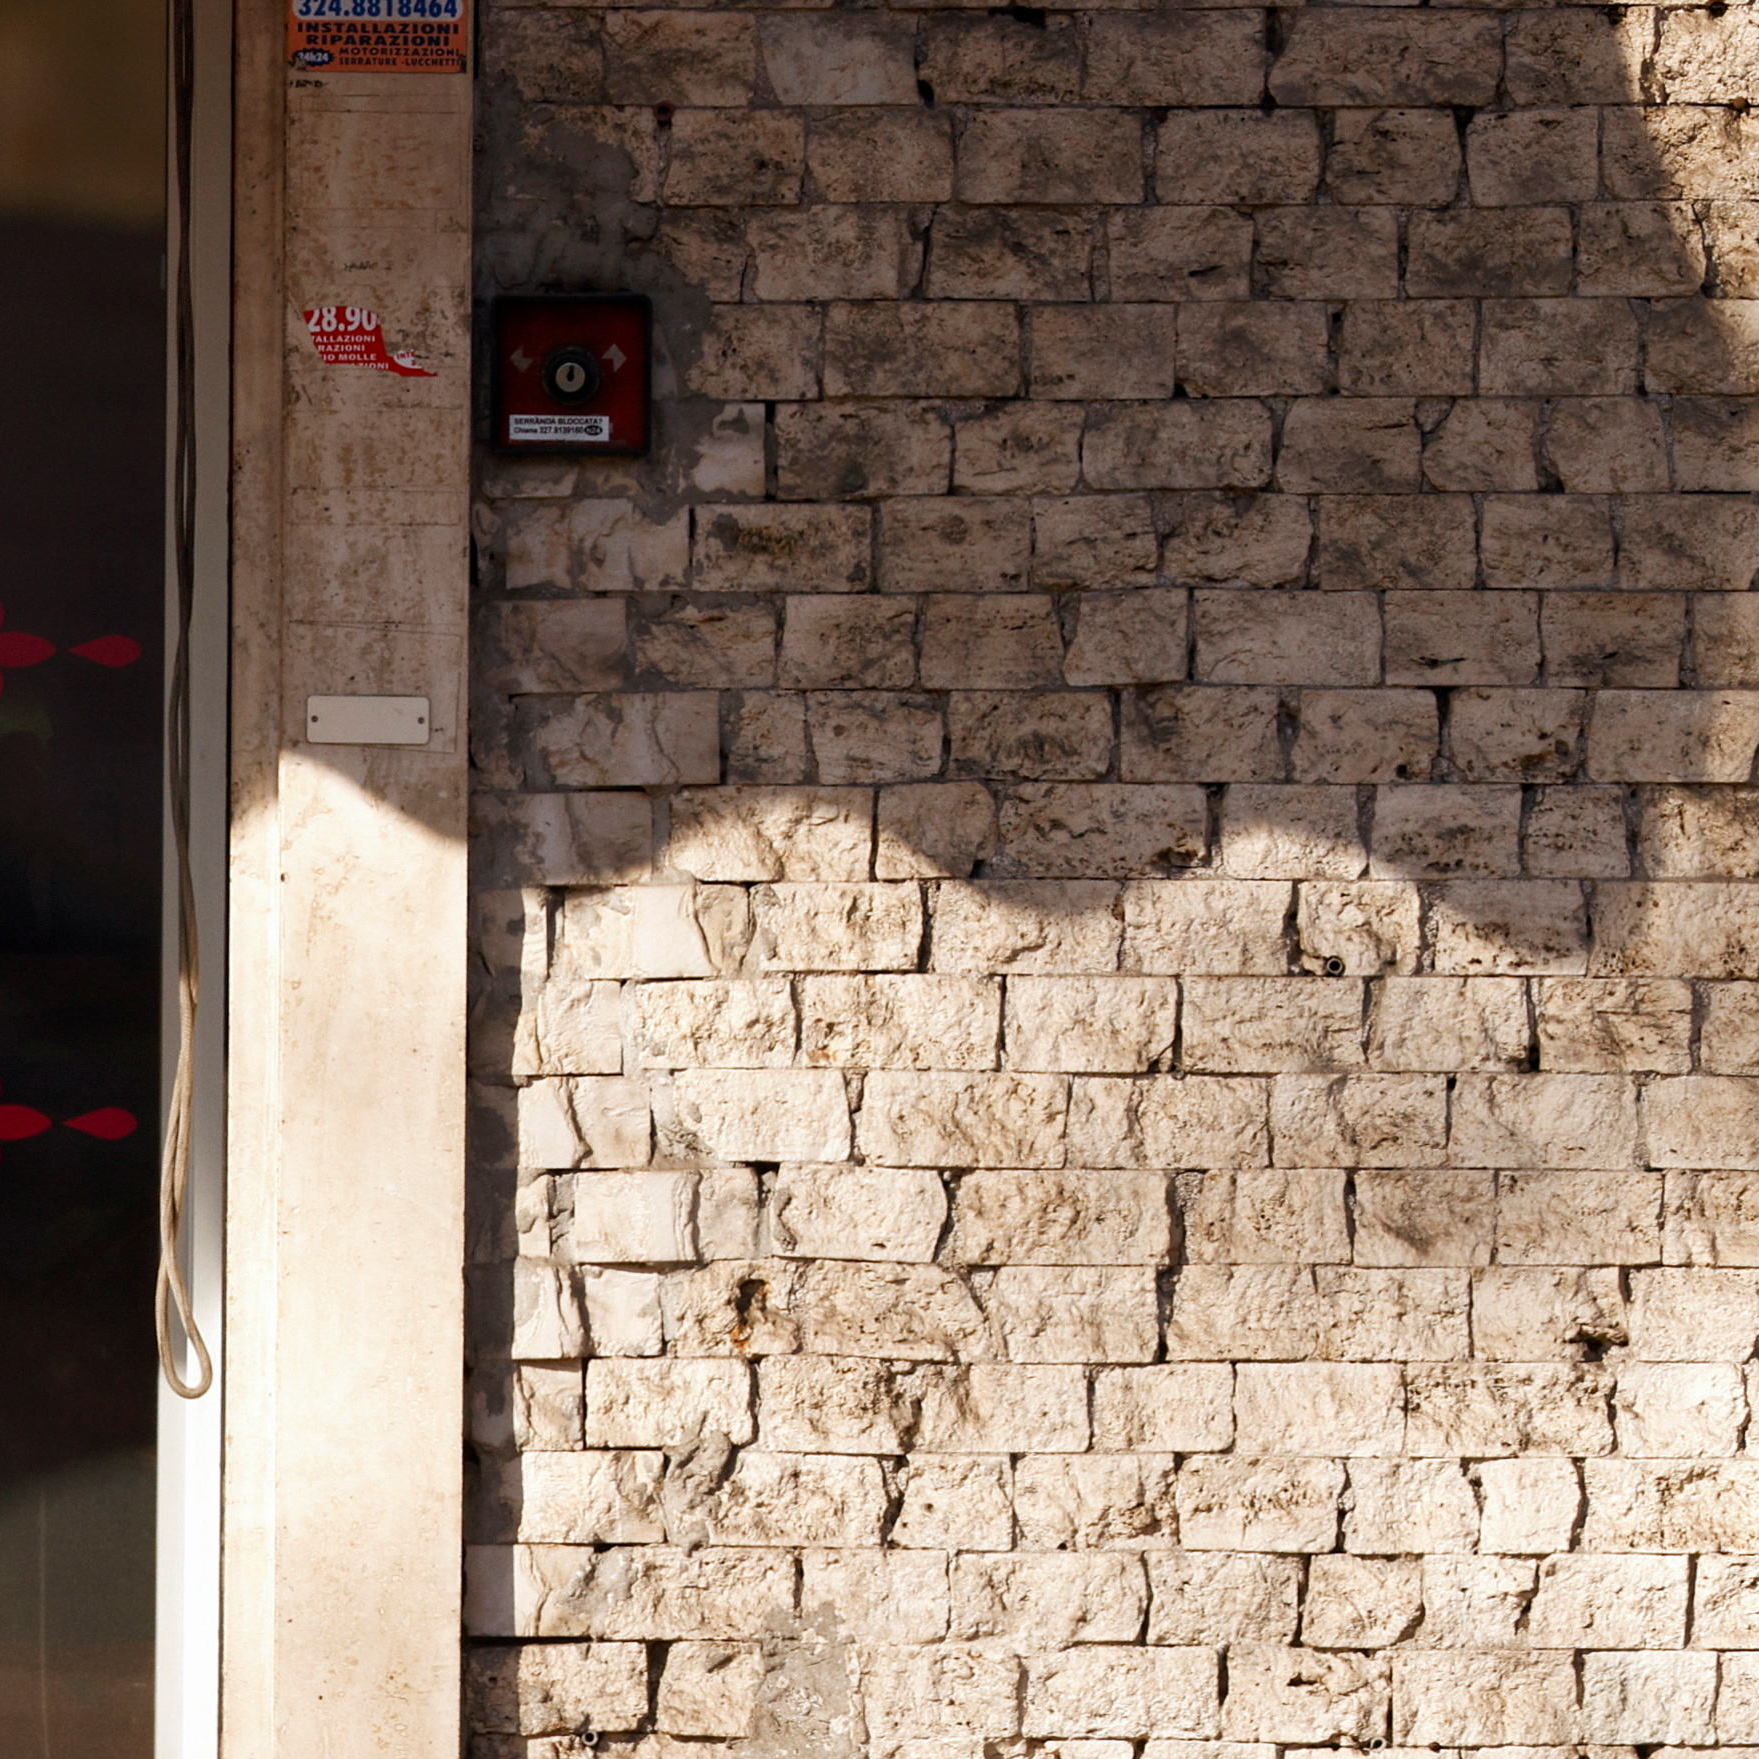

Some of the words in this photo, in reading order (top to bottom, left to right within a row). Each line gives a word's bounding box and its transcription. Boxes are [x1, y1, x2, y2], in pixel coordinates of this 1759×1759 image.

[297, 23, 459, 34] INSTALLAZIONI
[306, 35, 450, 46] RIPARAZIONI
[339, 48, 459, 57] MOTORIZZAZIONI
[339, 57, 397, 66] SERRATURE
[338, 353, 377, 361] MOLLE
